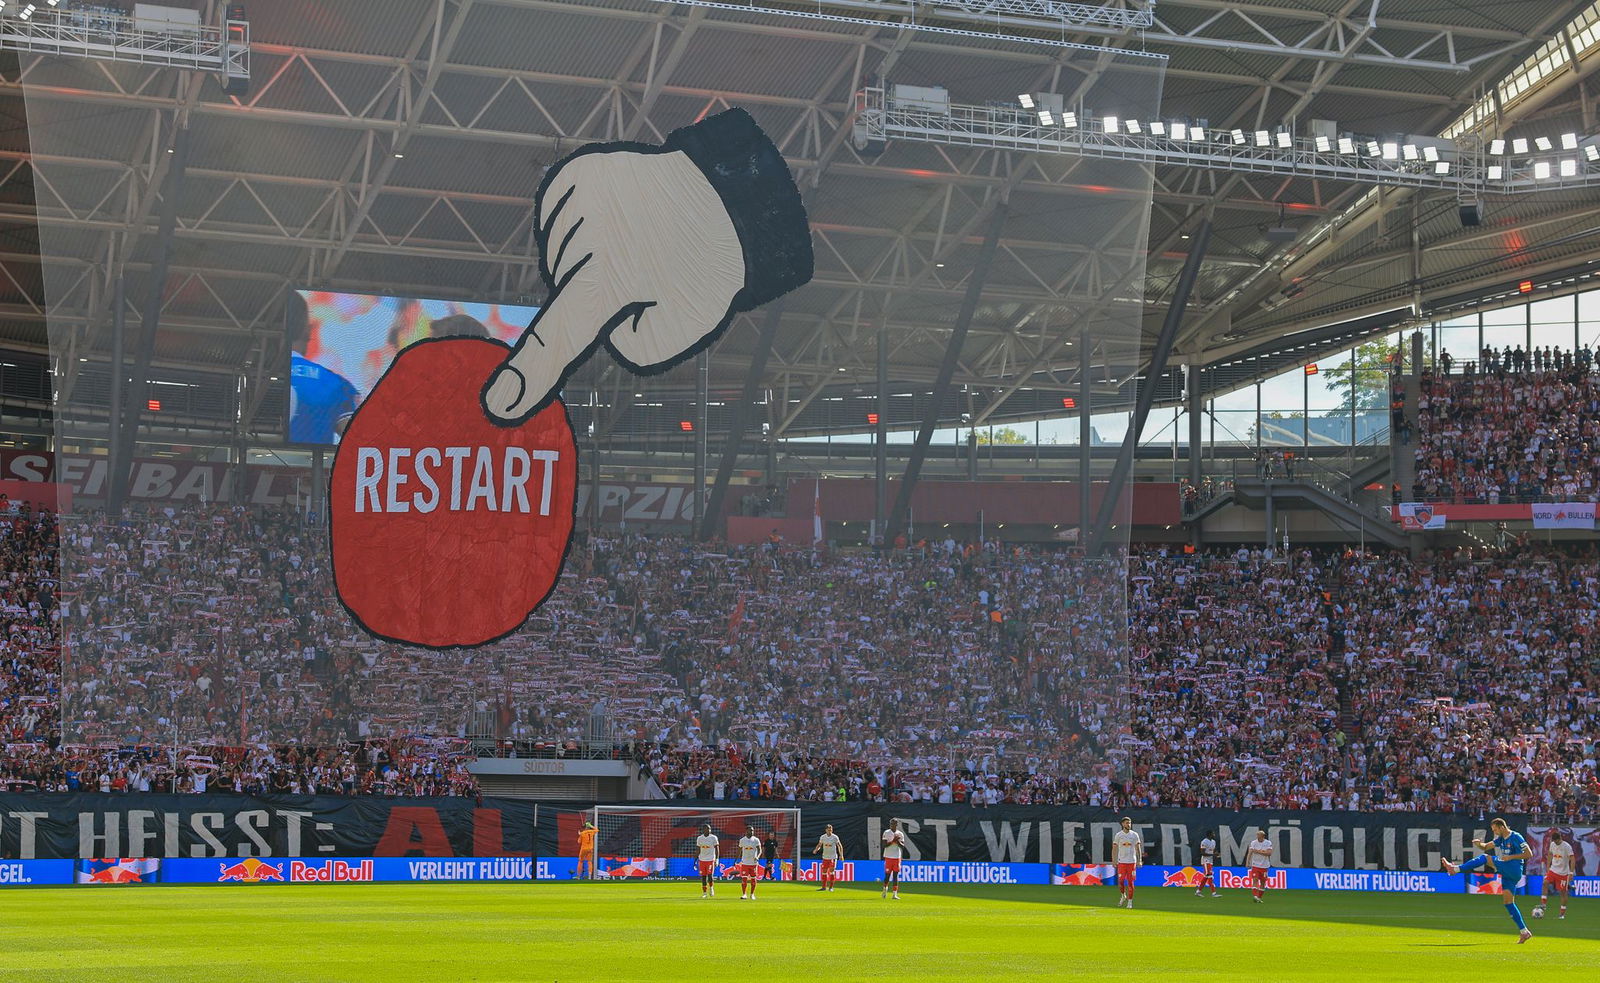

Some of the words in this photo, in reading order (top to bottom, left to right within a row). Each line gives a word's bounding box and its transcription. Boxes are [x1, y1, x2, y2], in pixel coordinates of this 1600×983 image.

[354, 446, 559, 516] RESTART
[1567, 512, 1595, 520] BULLEN
[524, 760, 565, 773] SÜDTOR
[867, 816, 956, 862] IST
[290, 859, 332, 882] Red
[333, 859, 374, 882] Bull
[409, 861, 476, 880] VERLEIHT
[889, 864, 945, 883] ERLEIHT
[948, 862, 1017, 884] FLÜÜÜGEL.
[1314, 872, 1369, 890] VERLEIHT
[1372, 871, 1436, 893] FLÜÜÜGEL.
